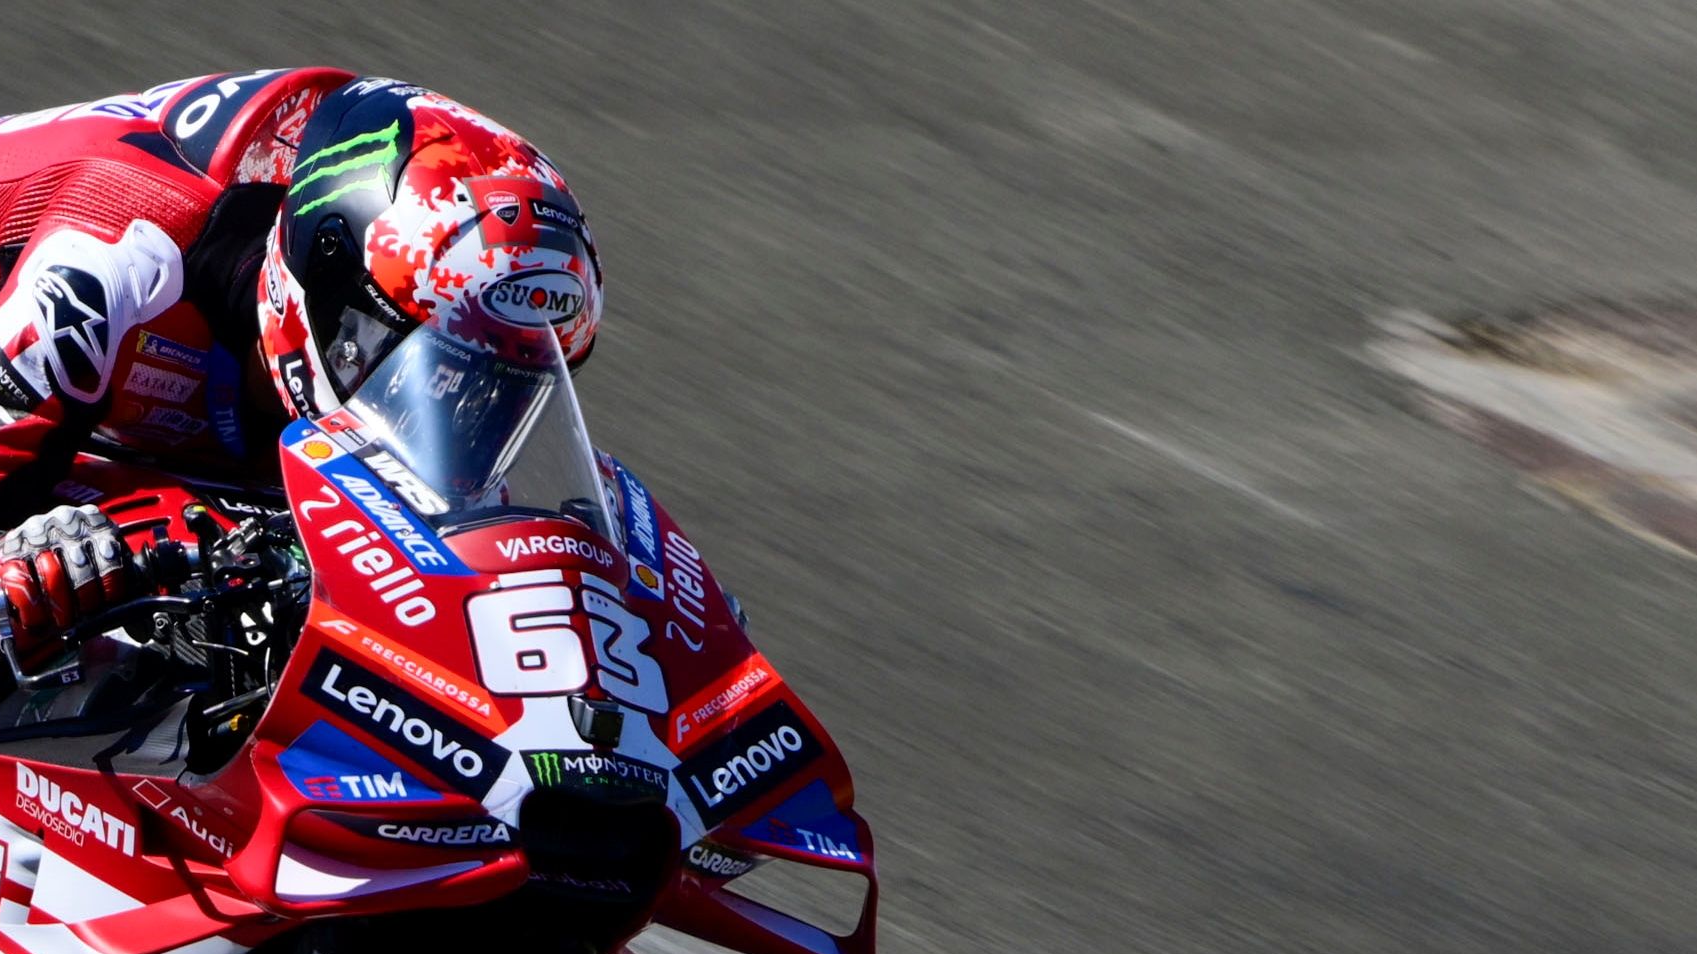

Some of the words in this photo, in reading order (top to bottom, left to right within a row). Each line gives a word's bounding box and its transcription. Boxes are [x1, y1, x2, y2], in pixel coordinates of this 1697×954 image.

[364, 283, 407, 324] SUOMY
[495, 281, 582, 315] SUOMY
[216, 407, 237, 443] TIM
[332, 473, 448, 567] ADVANCE
[321, 519, 437, 627] riello
[495, 535, 614, 568] VARGROUP
[665, 530, 705, 629] riello
[467, 582, 670, 715] 63
[61, 670, 81, 684] 63
[361, 636, 491, 717] FRECCIAROSSA
[692, 667, 769, 724] FRECCIAROSSA
[320, 663, 484, 778] Lenovo
[340, 771, 408, 799] TIM
[562, 752, 668, 790] MONSTER
[690, 725, 803, 809] Lenovo
[15, 760, 136, 858] DUCATI
[15, 793, 85, 848] DESMOSEDICI
[170, 805, 234, 858] Audi
[377, 822, 512, 845] CARRERA
[796, 827, 858, 861] TIM
